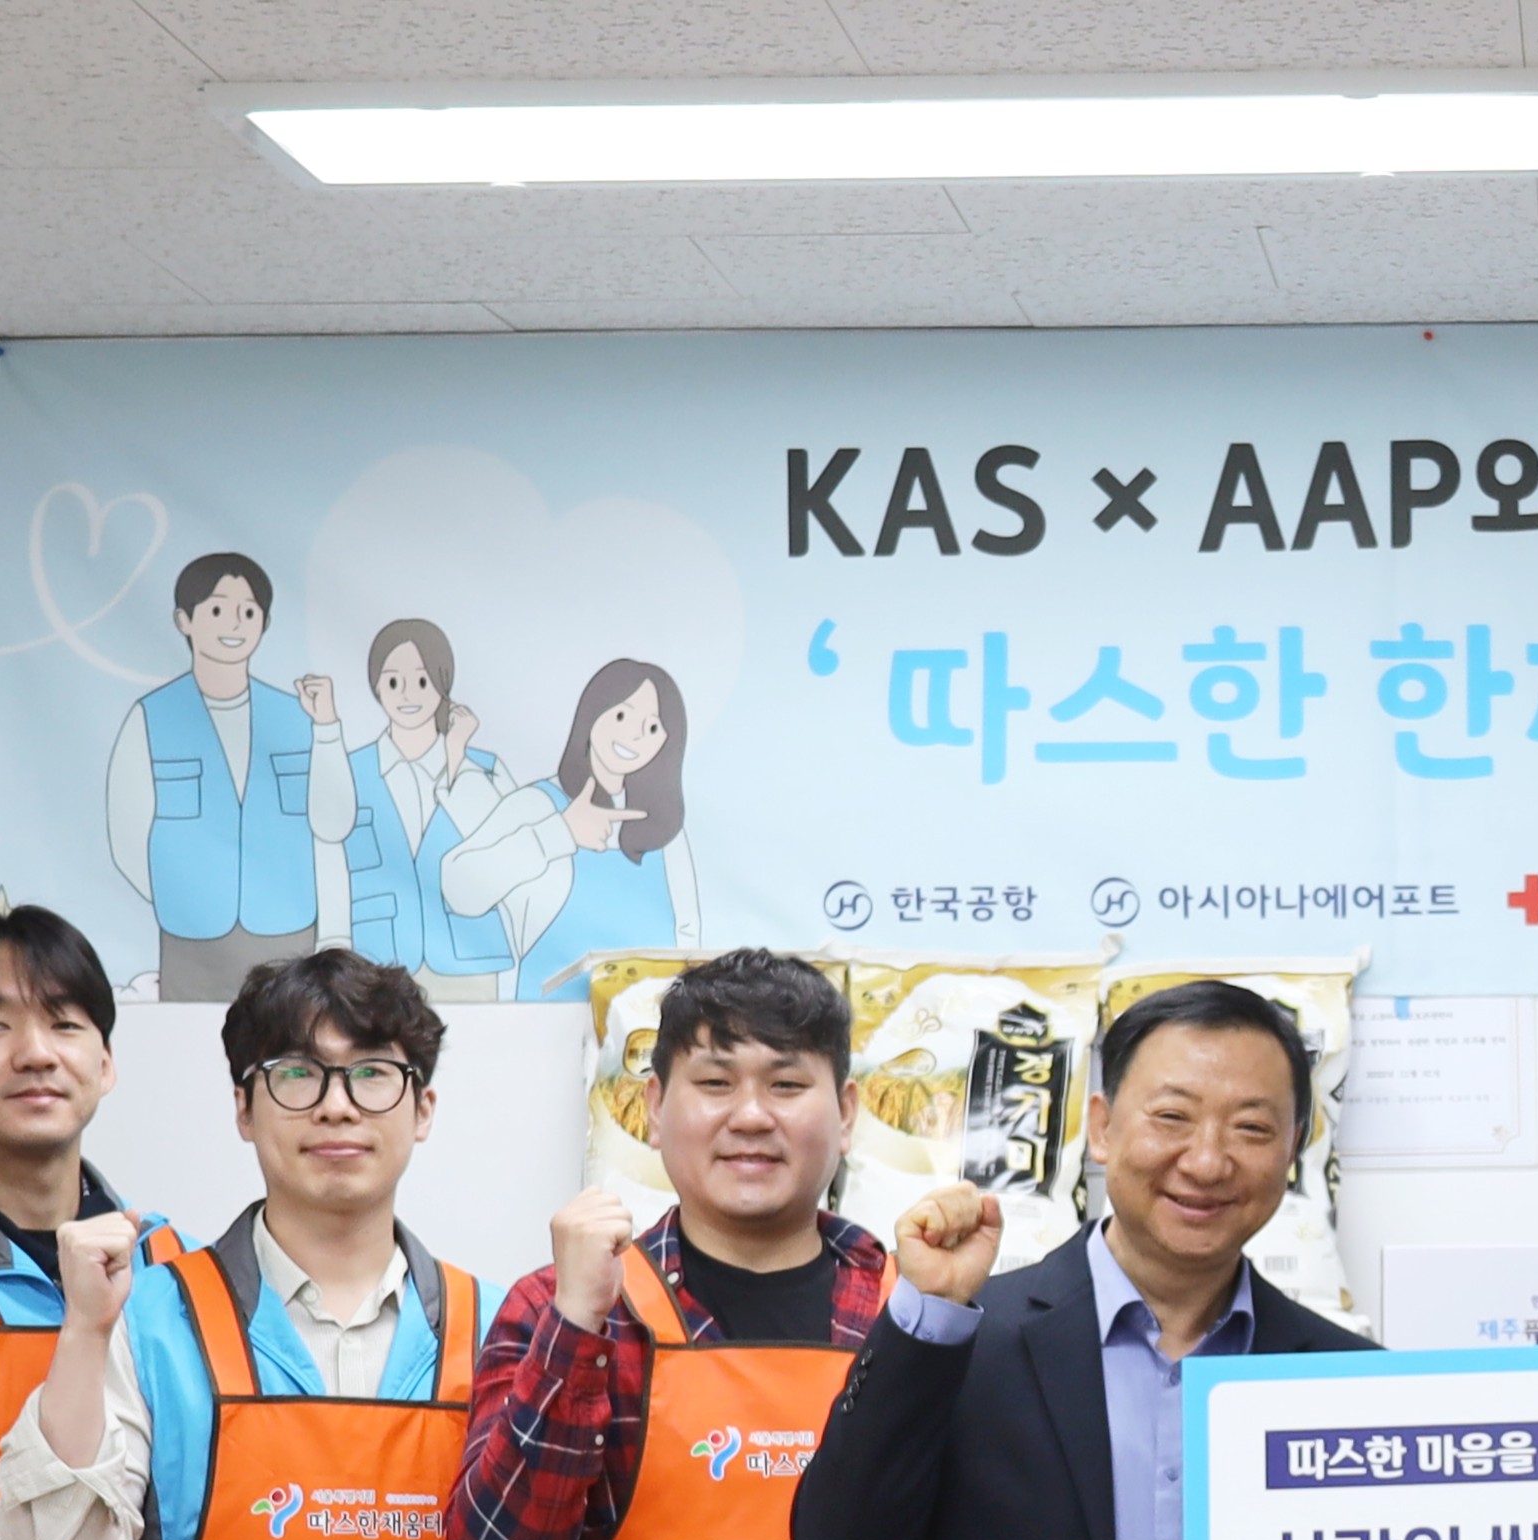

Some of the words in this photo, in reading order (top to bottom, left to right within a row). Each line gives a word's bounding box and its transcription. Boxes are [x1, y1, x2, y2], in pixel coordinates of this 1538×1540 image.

[786, 444, 1047, 558] KAS
[890, 884, 1038, 923] 한국공항
[1157, 881, 1460, 920] 아시아나에어포트
[1005, 1051, 1055, 1185] 경기미
[1286, 1433, 1406, 1482] 따스한
[1416, 1429, 1538, 1477] 마음을
[307, 1508, 444, 1539] 따스한채움터
